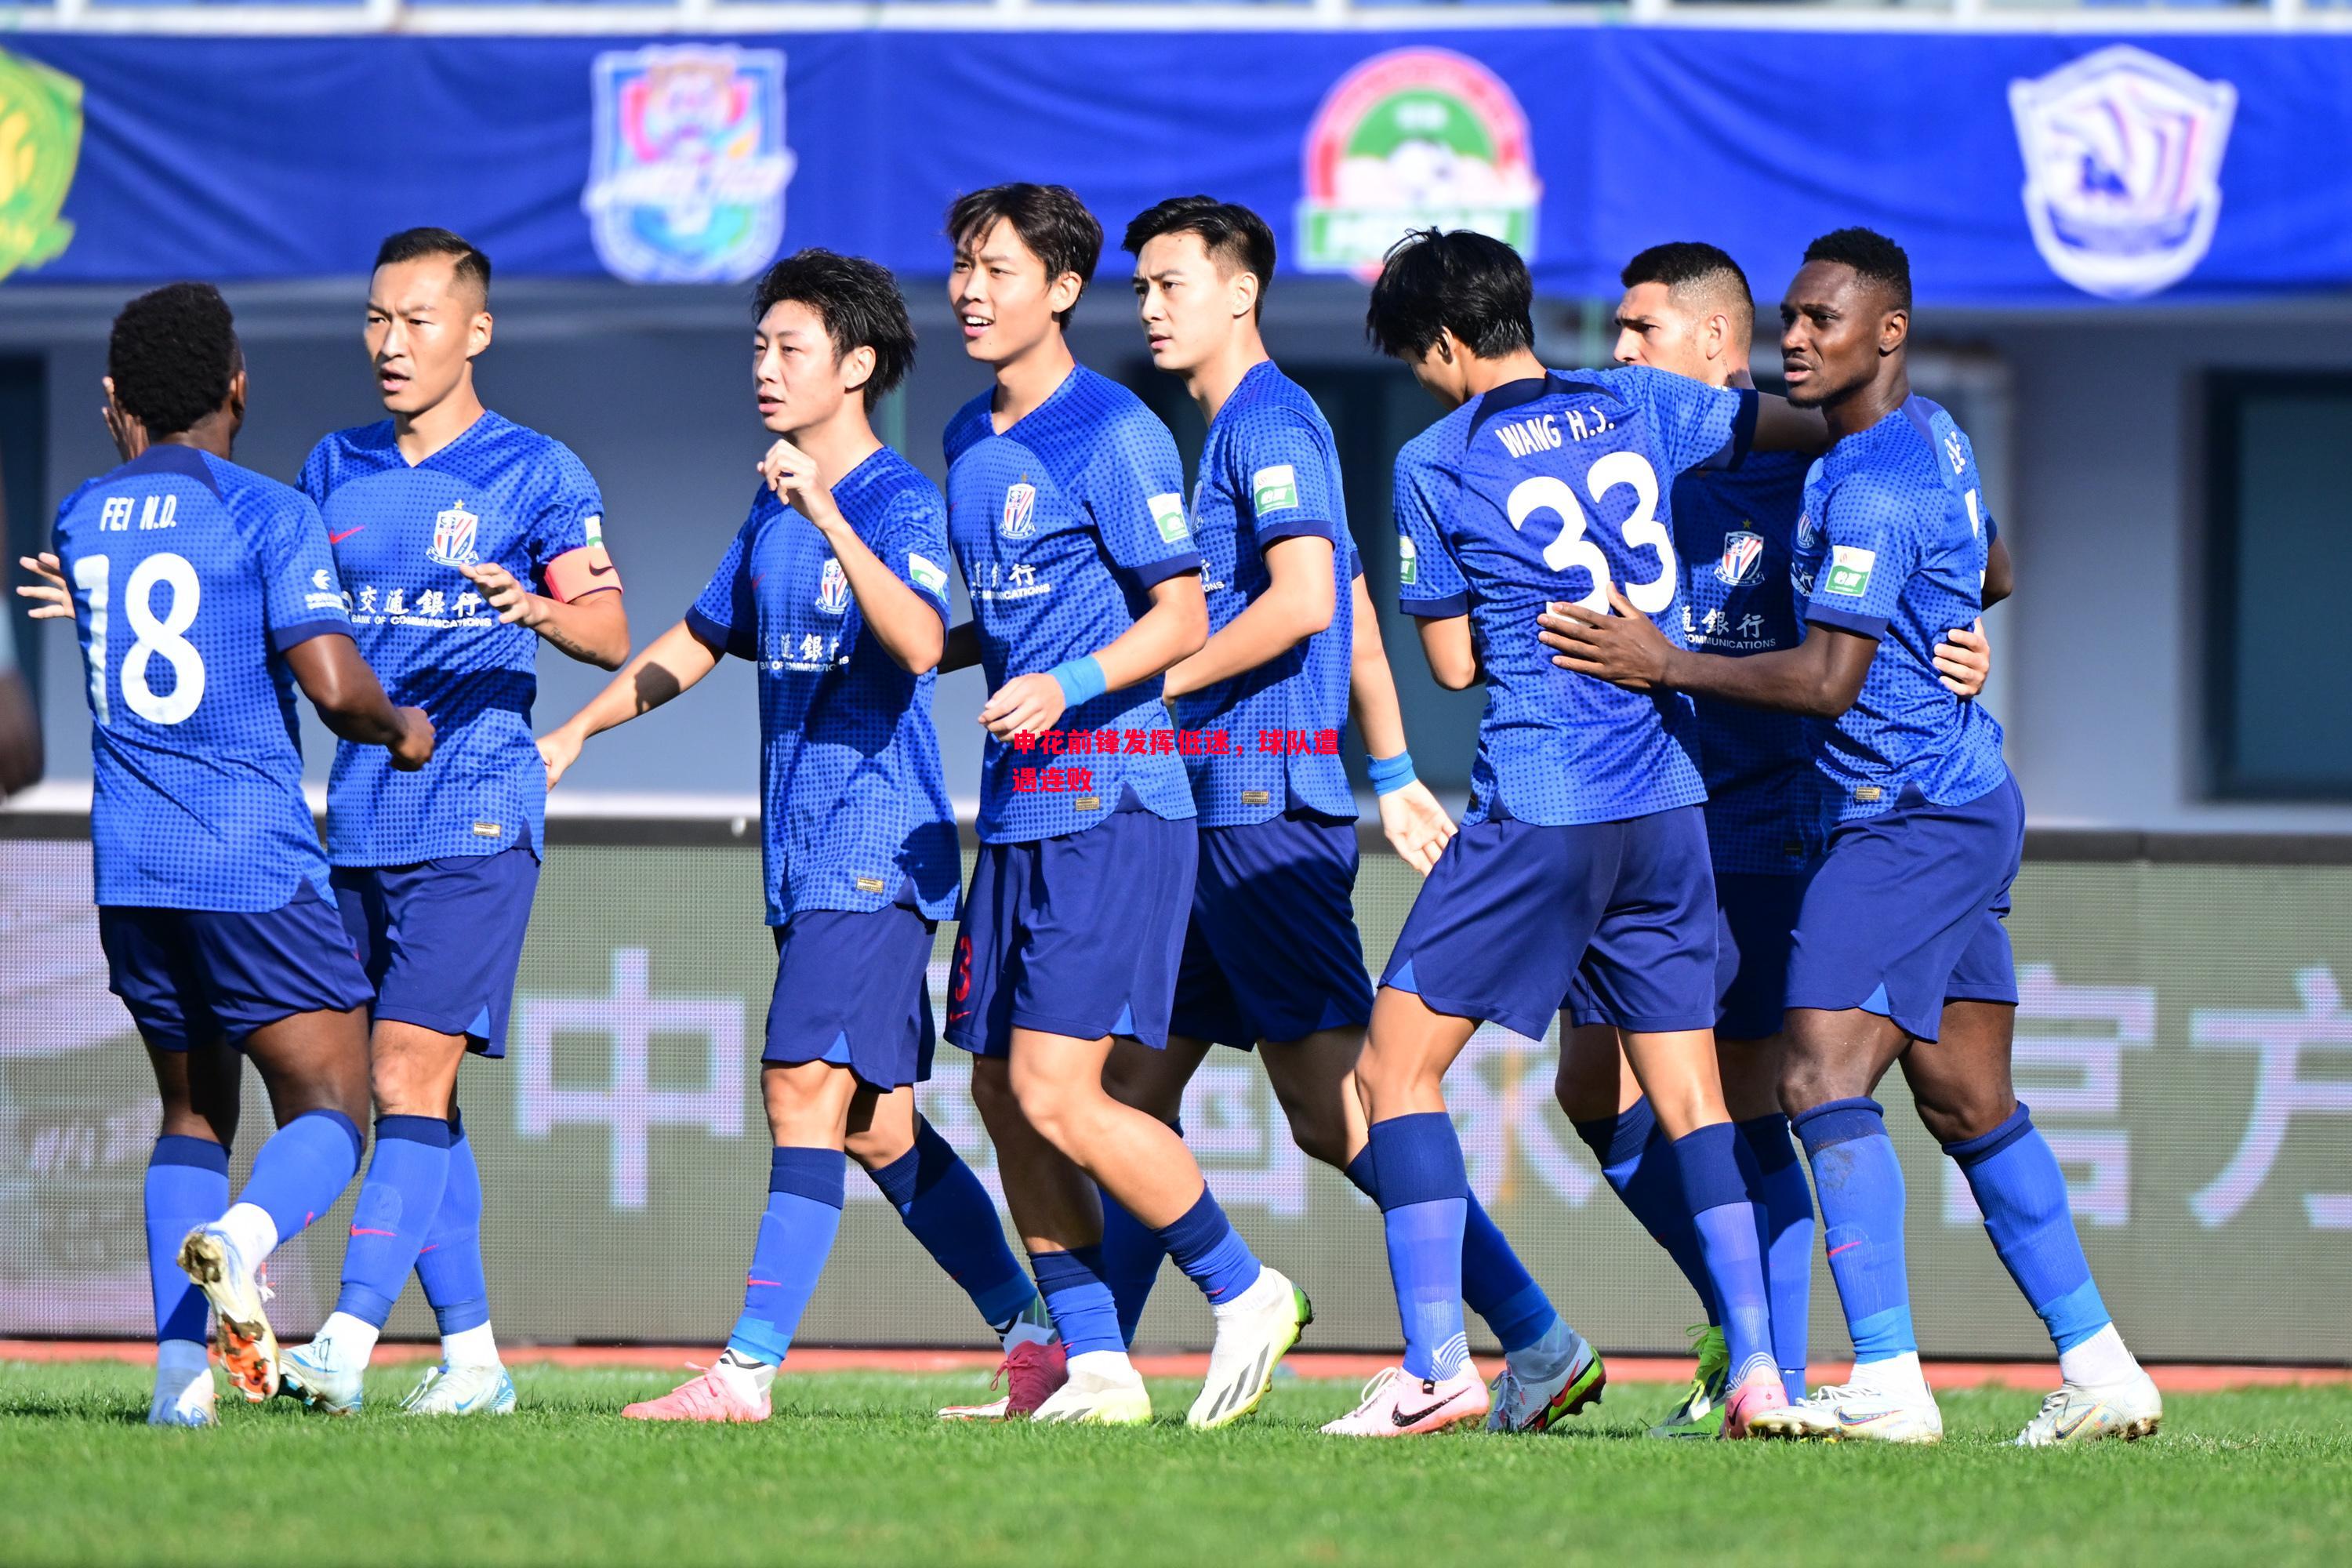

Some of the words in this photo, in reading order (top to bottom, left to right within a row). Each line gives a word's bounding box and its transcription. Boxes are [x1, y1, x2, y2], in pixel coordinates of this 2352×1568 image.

[1494, 414, 1562, 459] WANG
[1565, 405, 1615, 441] H.J.
[100, 496, 135, 532] FEI
[140, 494, 177, 531] N.D.
[1507, 451, 1676, 629] 33
[351, 615, 371, 624] BANK
[374, 615, 387, 625] OF
[390, 615, 492, 629] COMMUNICATIONS
[358, 585, 483, 617] 交通銀行
[74, 552, 205, 725] 18
